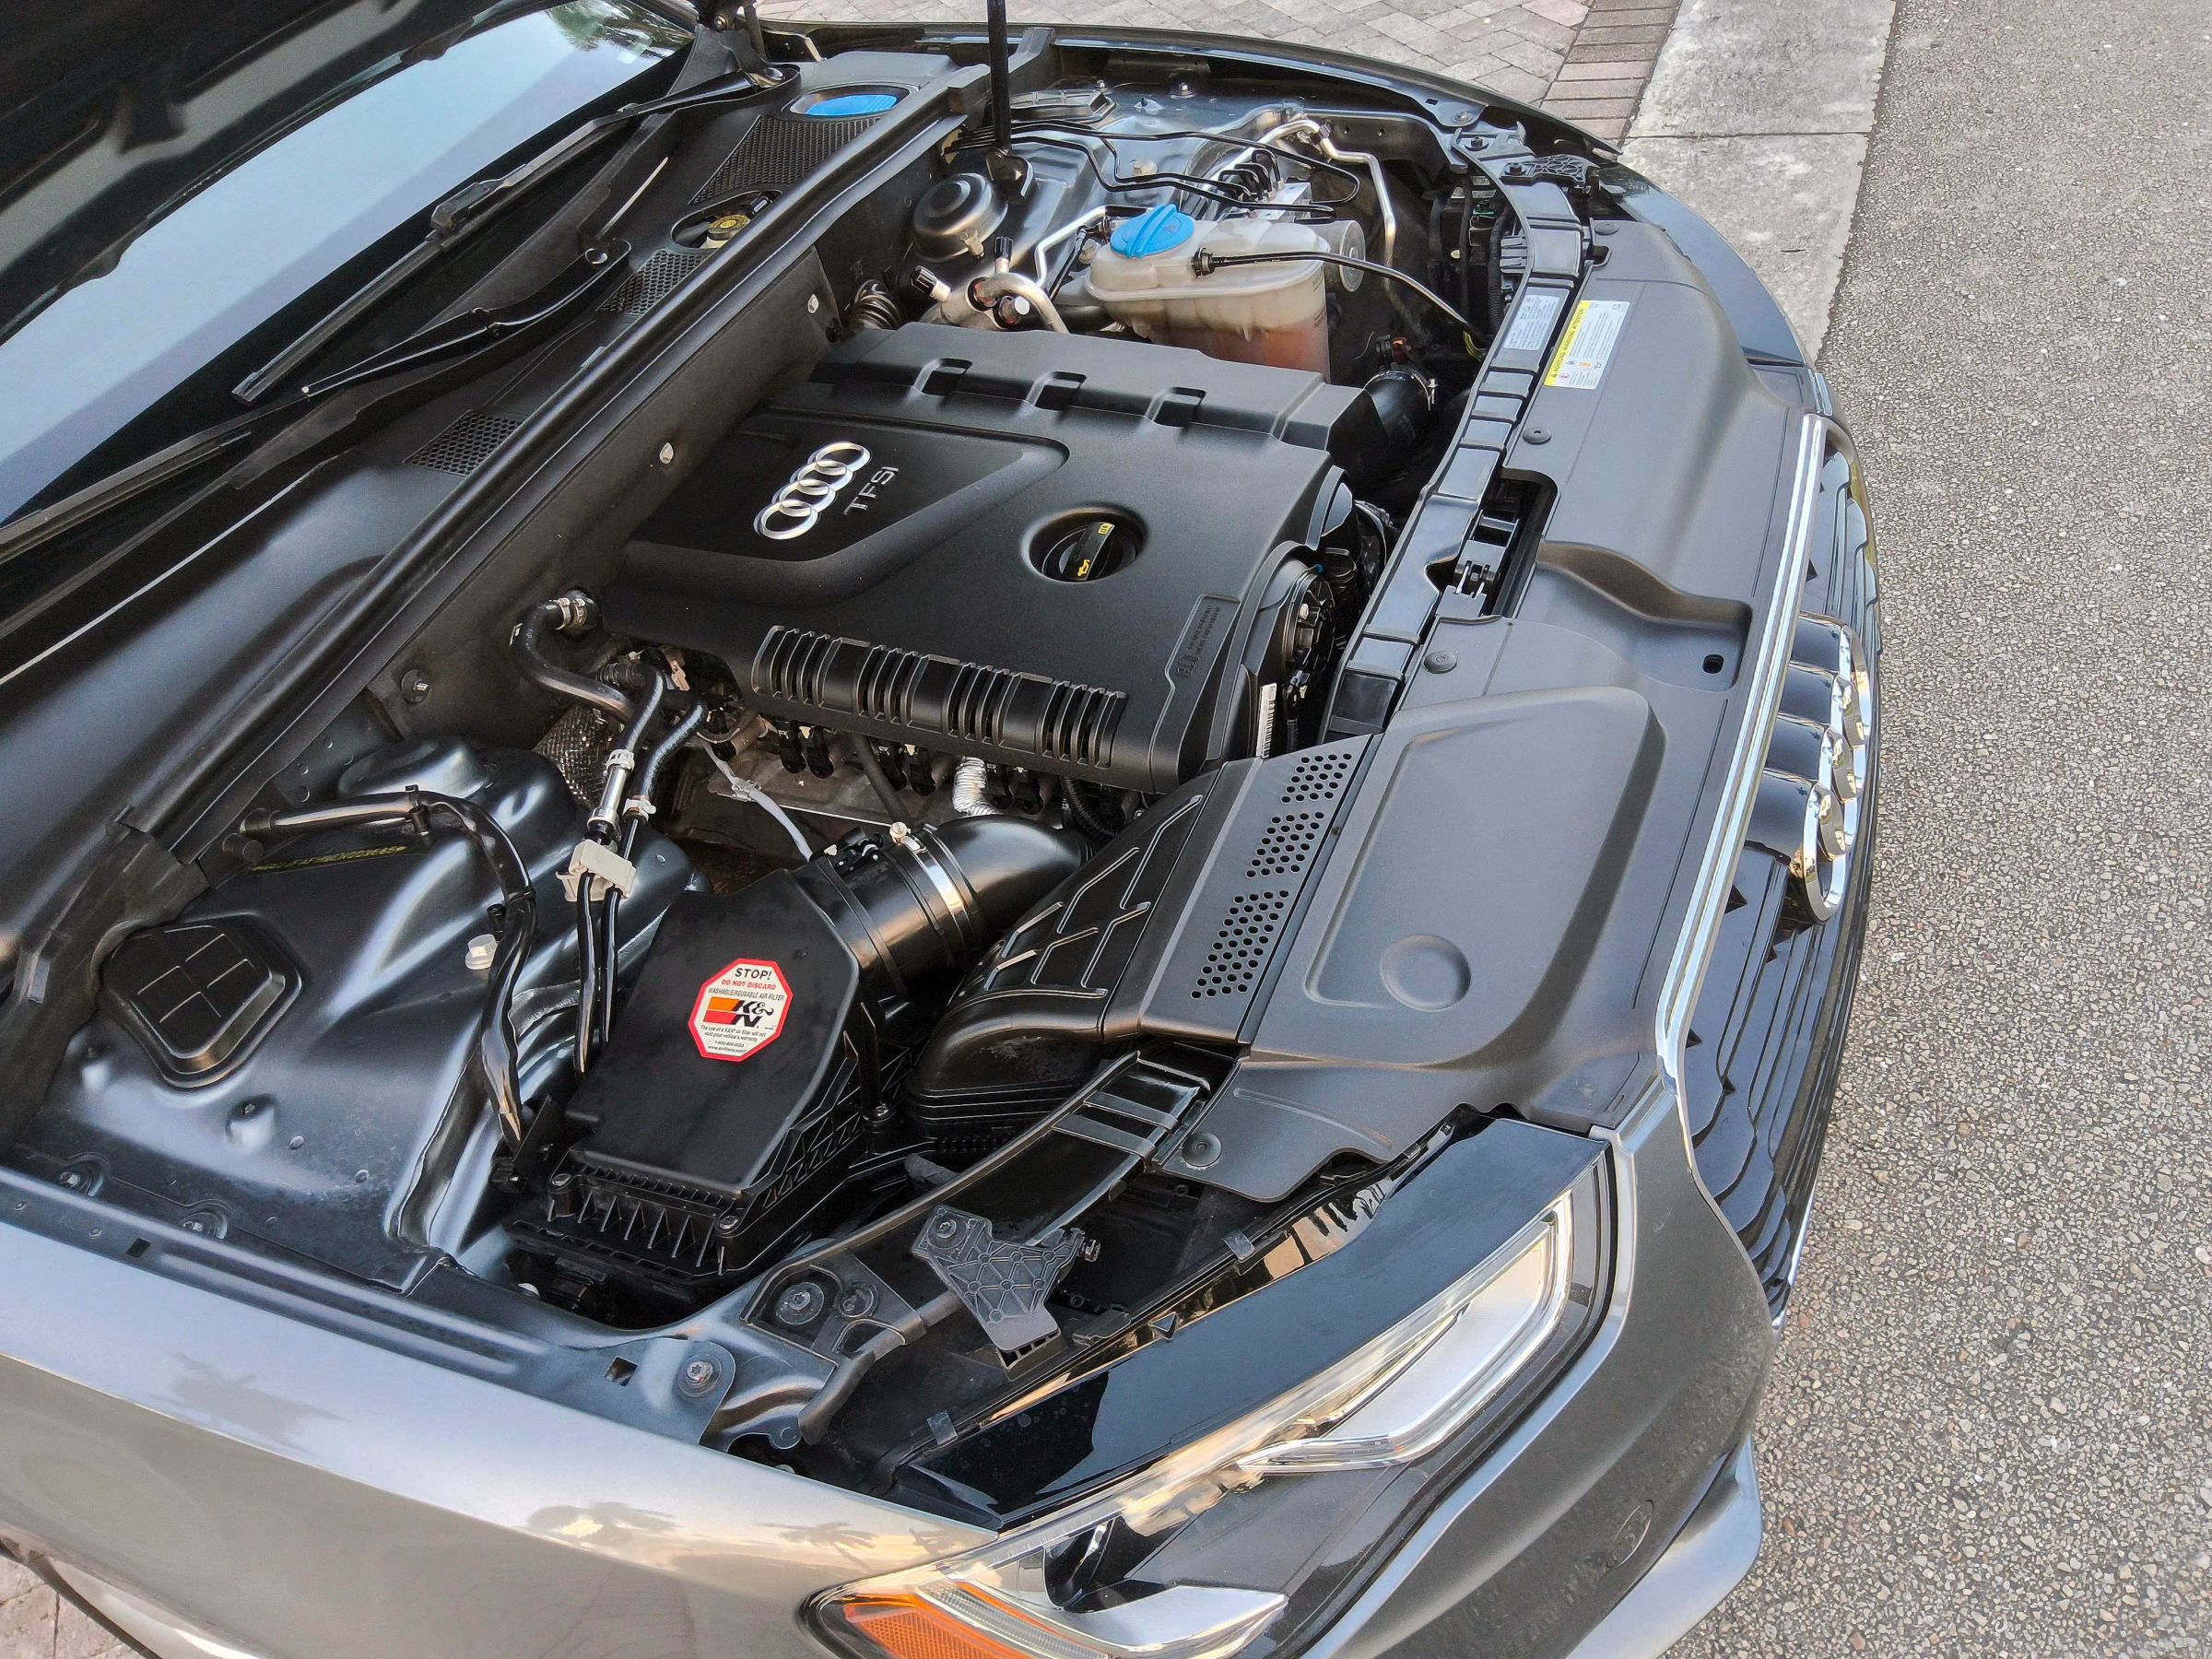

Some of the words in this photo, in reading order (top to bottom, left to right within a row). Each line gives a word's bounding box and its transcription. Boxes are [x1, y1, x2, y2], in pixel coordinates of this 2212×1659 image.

[843, 466, 900, 516] TFSI
[735, 968, 772, 981] STOP!
[708, 987, 759, 998] WASHABLE/REUSABLE
[747, 982, 777, 991] DISCARD
[730, 999, 774, 1028] K&N
